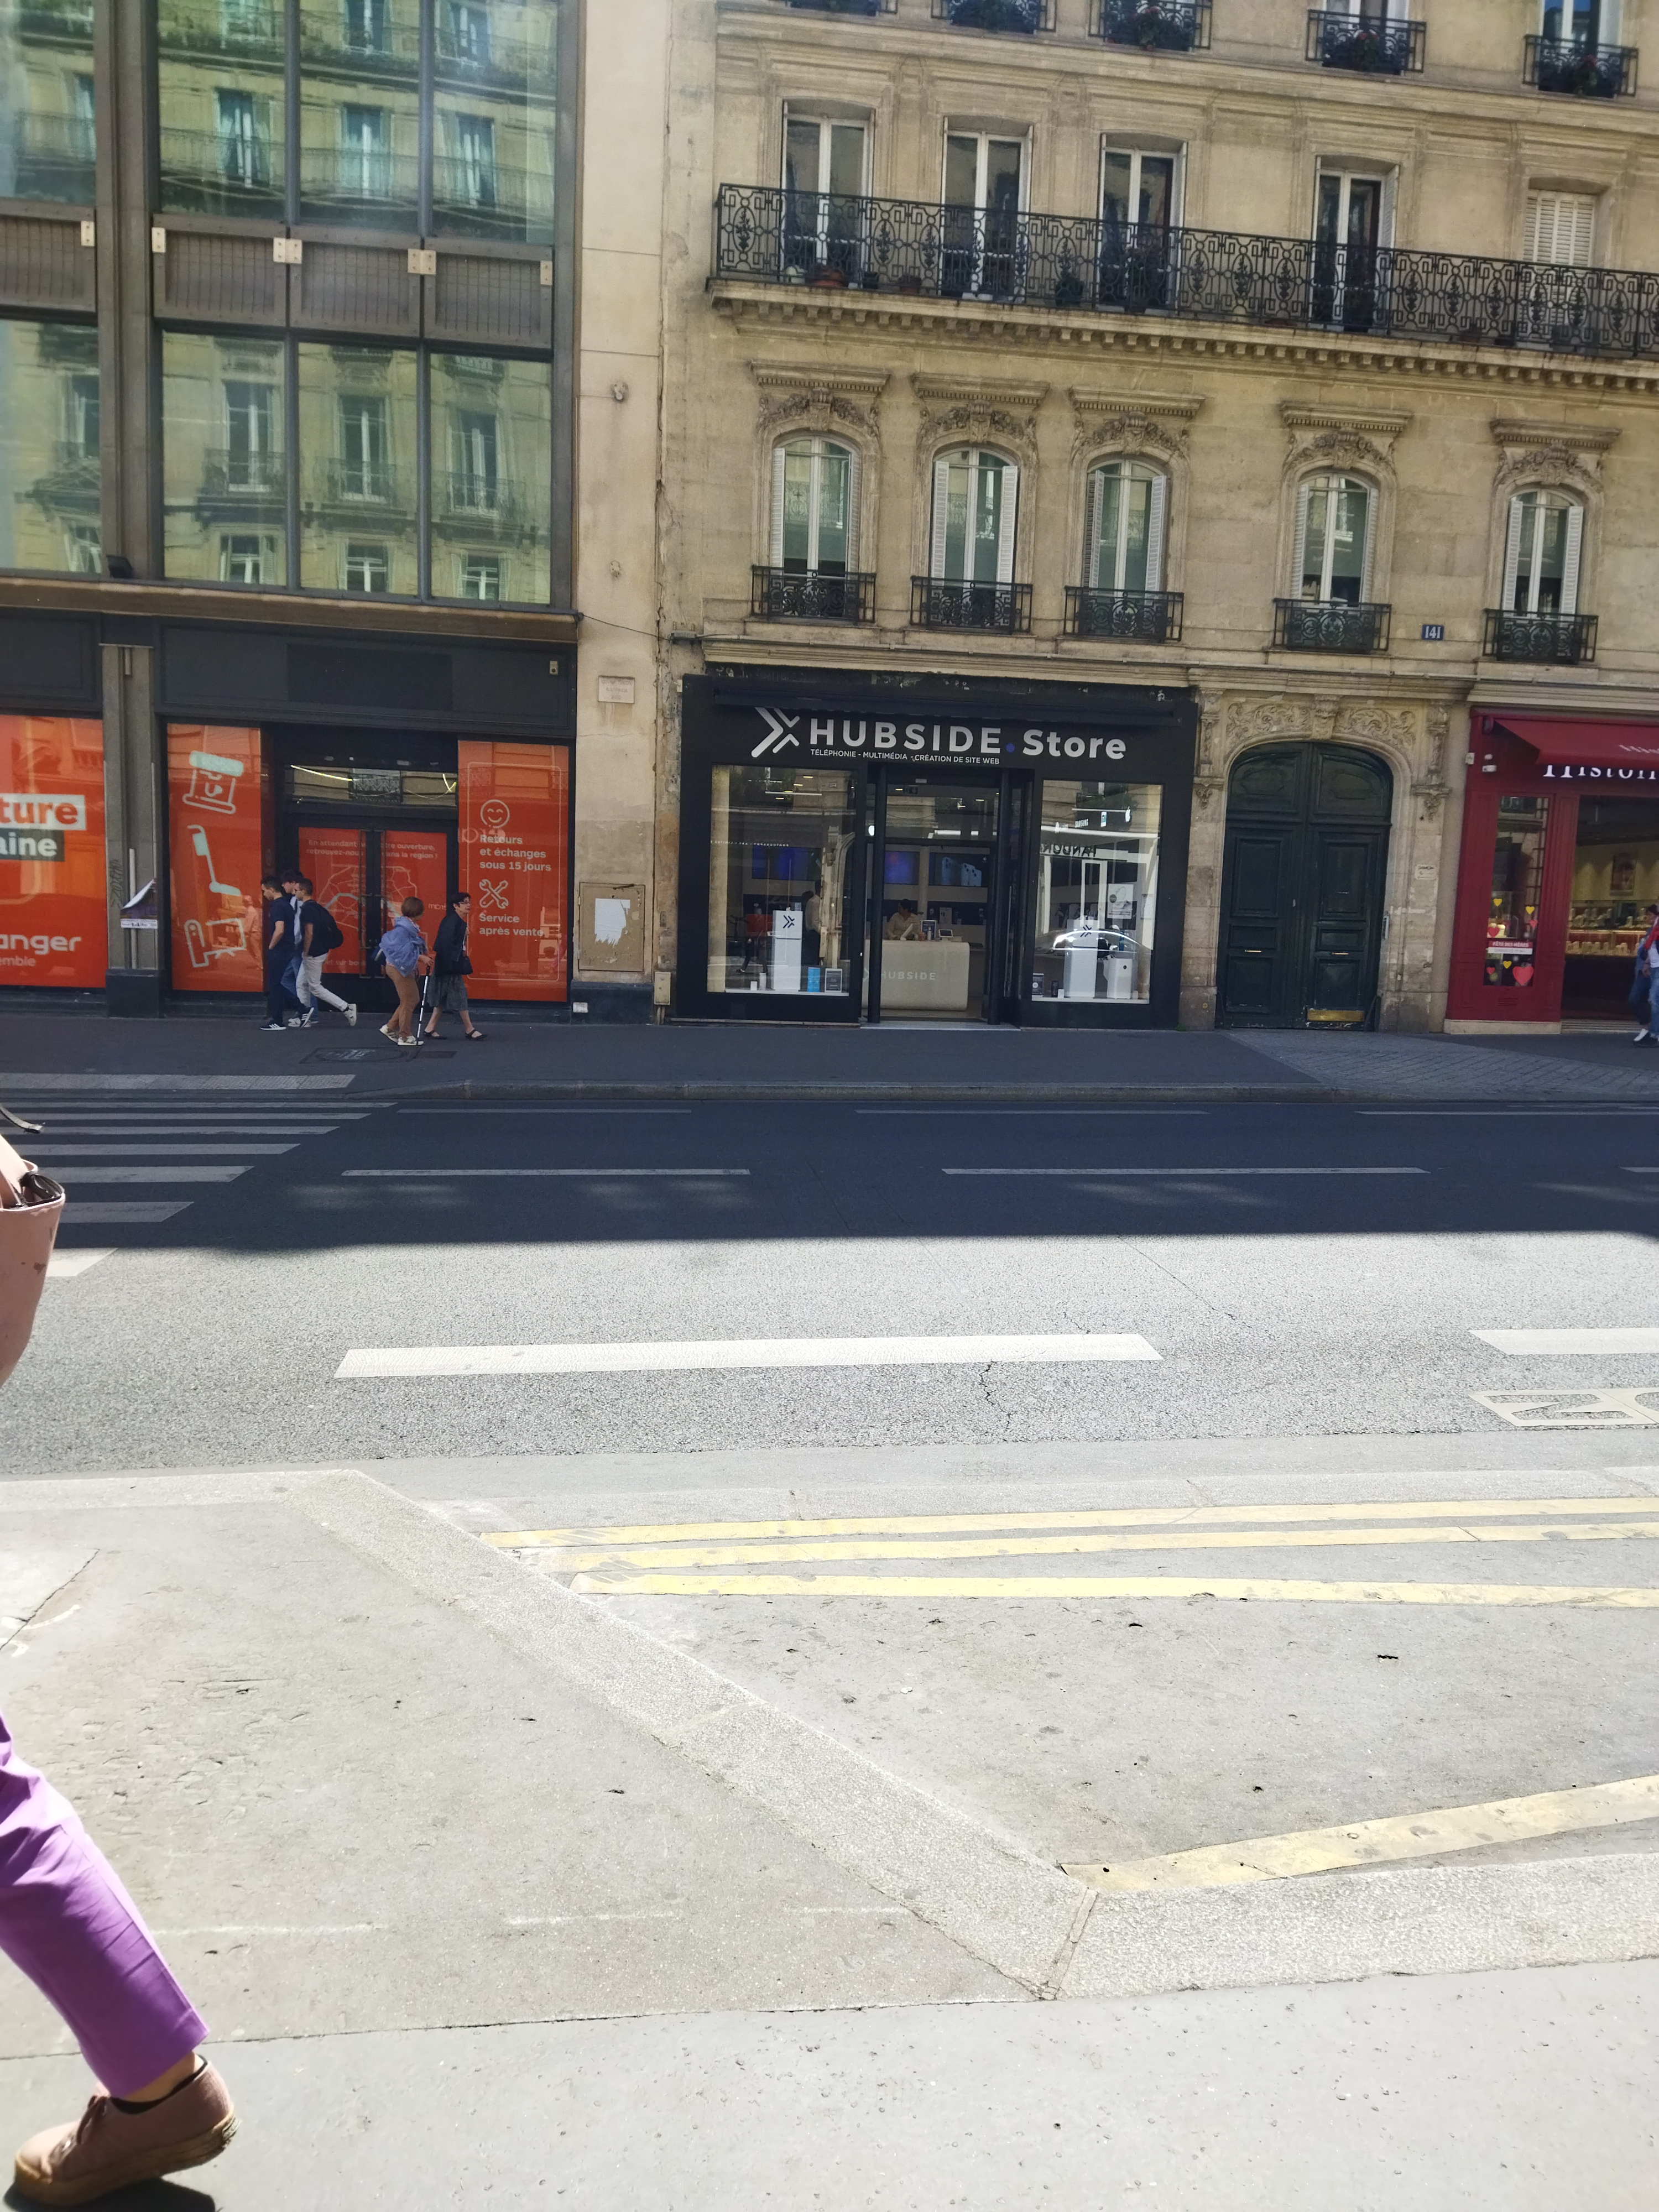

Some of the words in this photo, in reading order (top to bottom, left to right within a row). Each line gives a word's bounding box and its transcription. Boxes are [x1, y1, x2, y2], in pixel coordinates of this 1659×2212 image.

[1425, 625, 1441, 638] 141
[810, 718, 1001, 754] HUBSIDE
[1023, 729, 1126, 759] Store
[811, 748, 856, 758] TÉLÉPHONIE
[863, 751, 907, 760] MULTIMÉDIA
[915, 753, 952, 762] CRÉATION
[479, 834, 523, 844] Retours
[479, 848, 491, 856] et
[494, 848, 546, 859] échanges
[479, 862, 505, 870] sous
[509, 862, 521, 870] 15
[523, 862, 551, 872] jours
[479, 912, 520, 923] Service
[479, 926, 510, 936] après
[513, 928, 544, 936] vente
